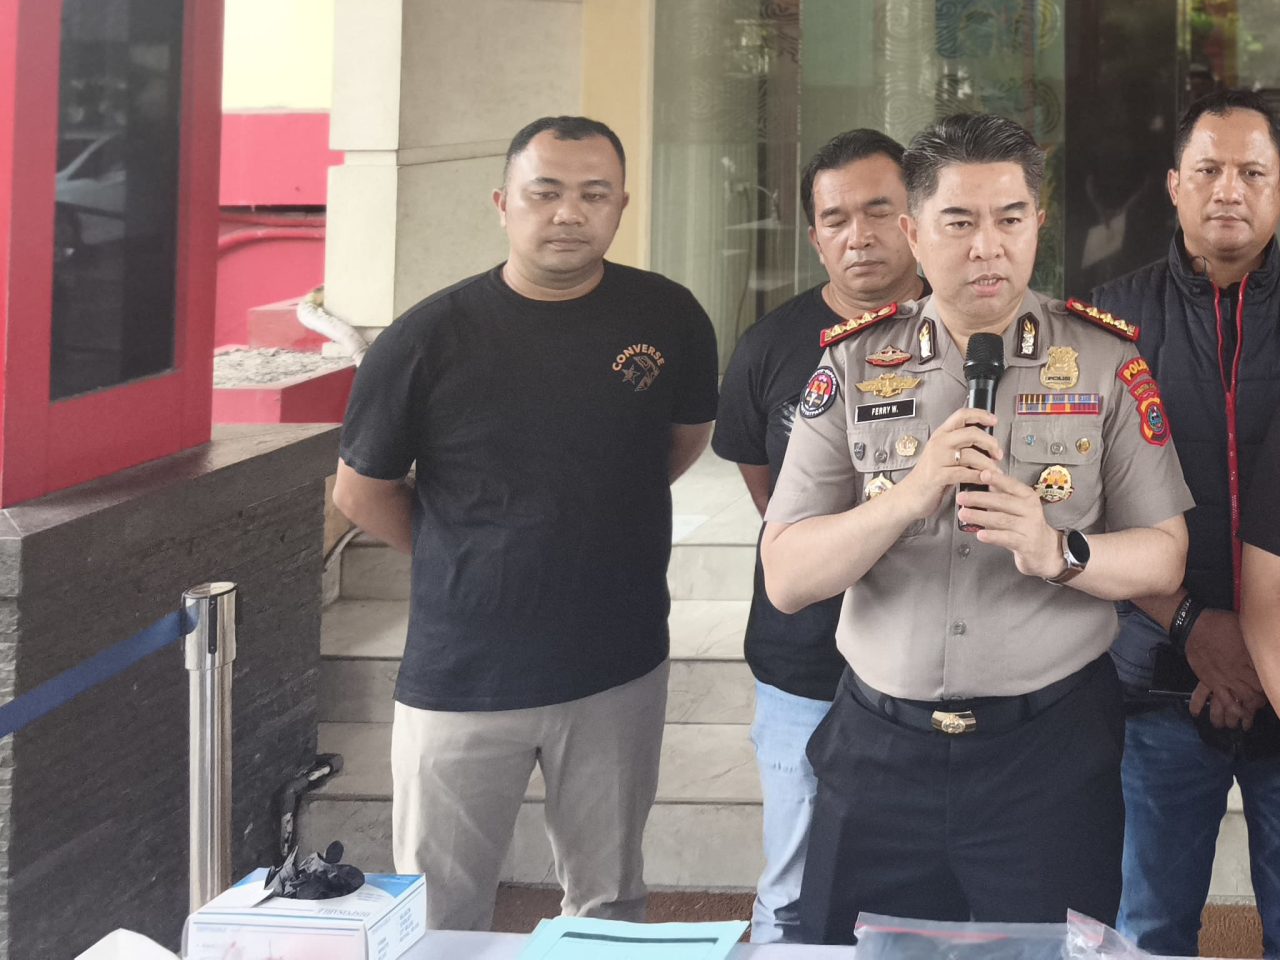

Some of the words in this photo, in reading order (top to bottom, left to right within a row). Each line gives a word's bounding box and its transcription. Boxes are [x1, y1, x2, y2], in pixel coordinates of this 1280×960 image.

[612, 344, 665, 371] CONVERSE
[871, 406, 891, 416] FERRY
[891, 405, 899, 414] W.
